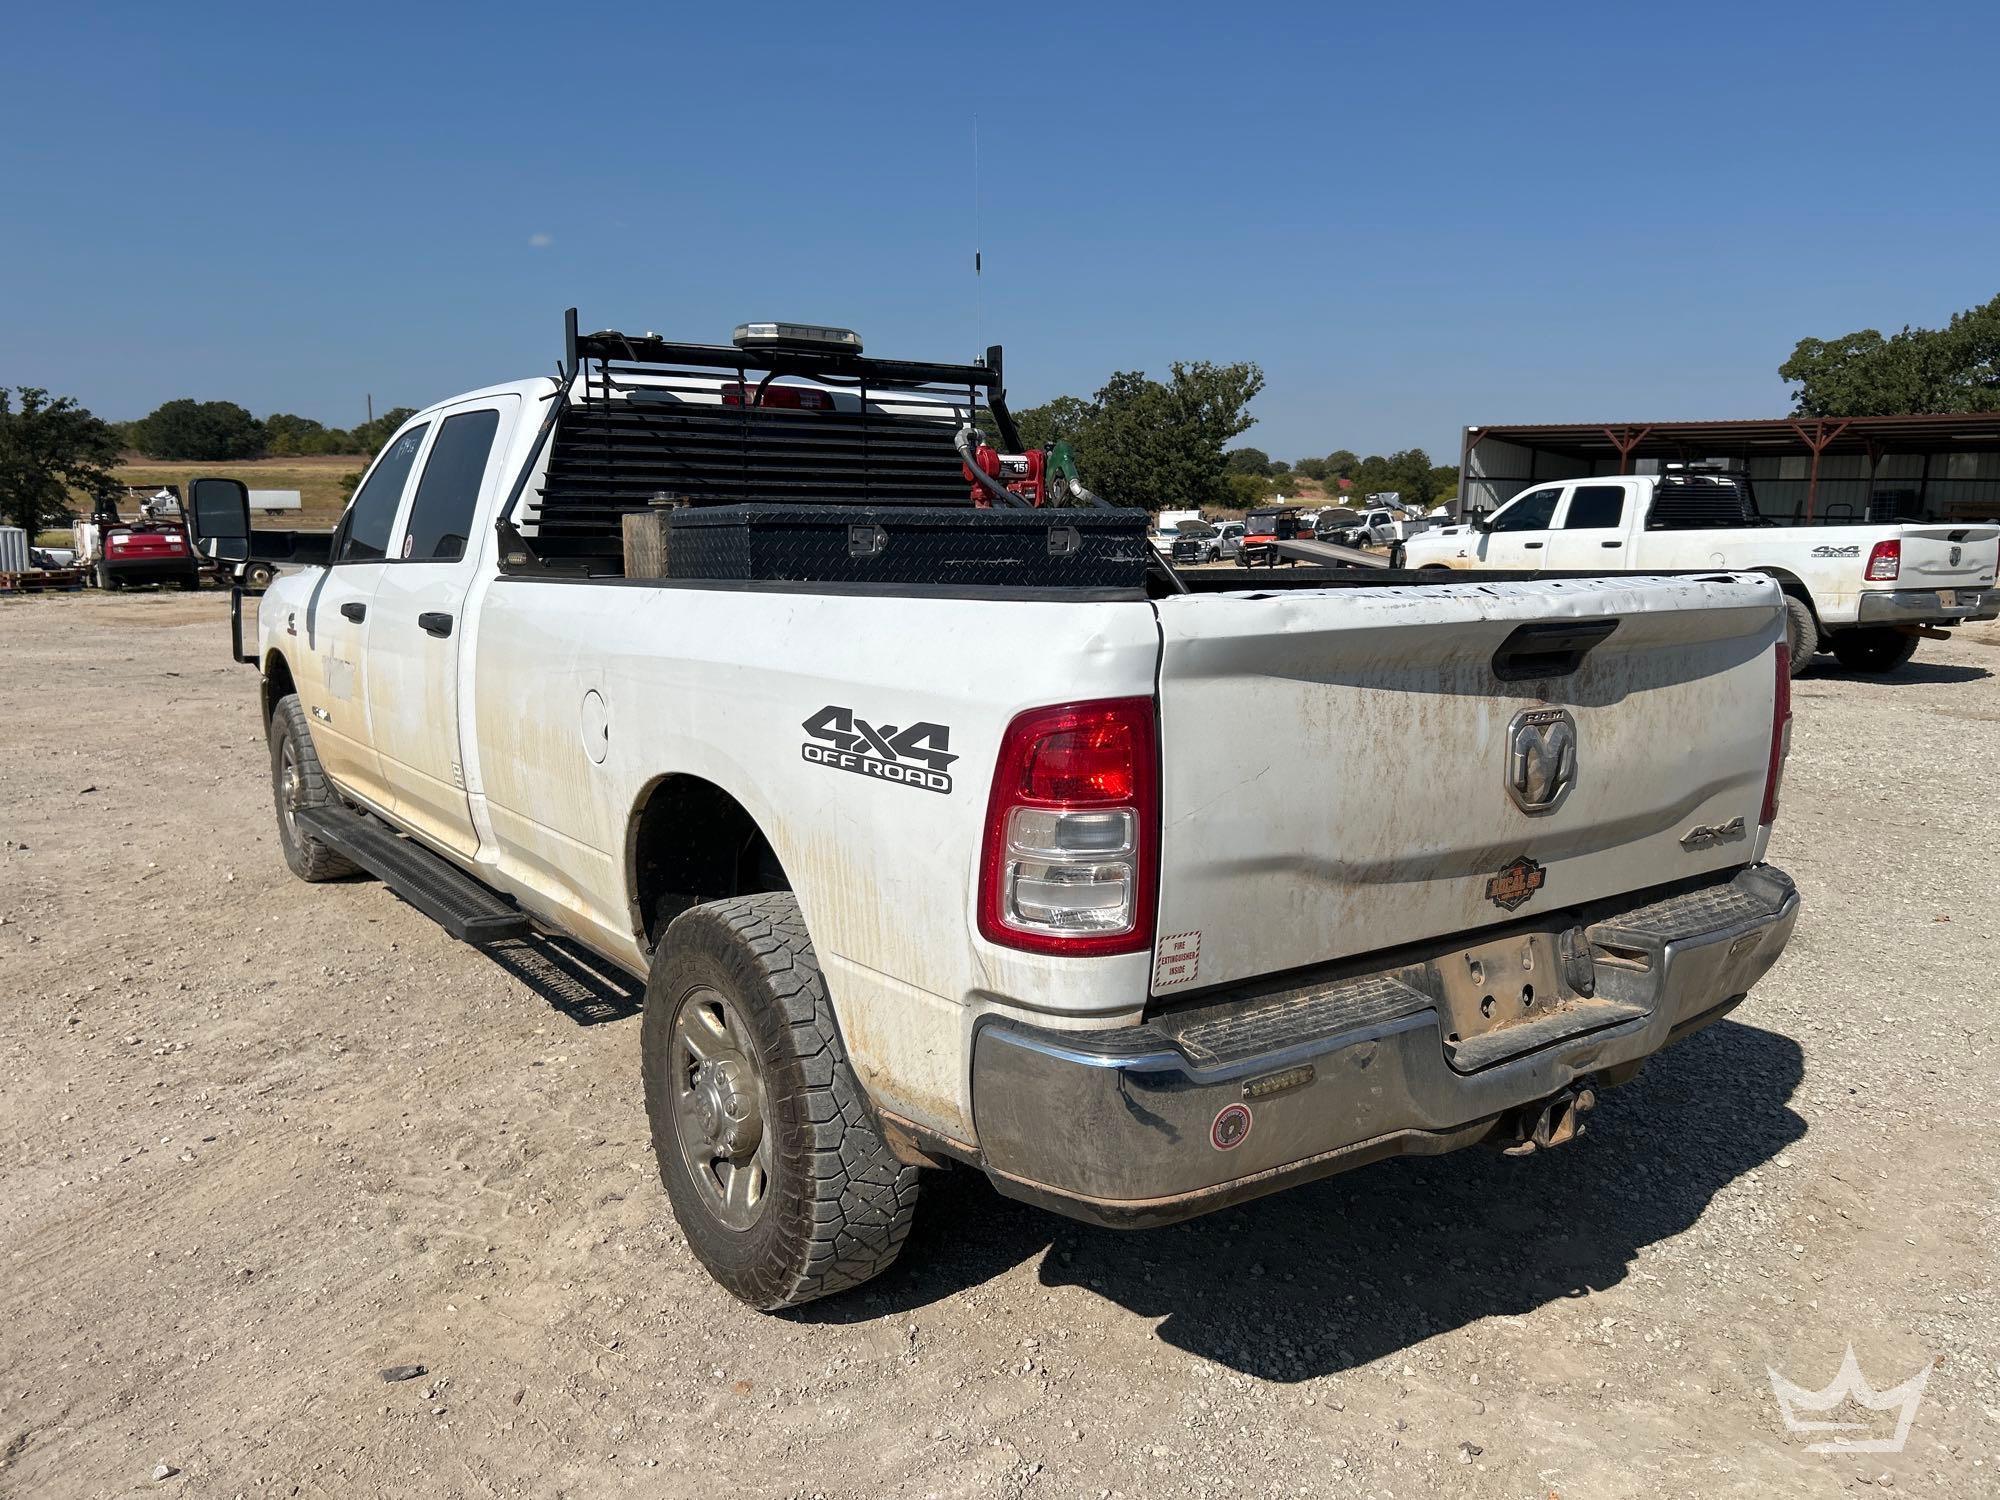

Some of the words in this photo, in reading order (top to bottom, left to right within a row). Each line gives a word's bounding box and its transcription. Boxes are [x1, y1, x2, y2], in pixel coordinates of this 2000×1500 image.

[804, 745, 857, 767] OFF
[863, 758, 949, 791] ROAD
[1174, 941, 1185, 950] FIRE
[1161, 952, 1196, 965] EXTINGUISHER
[1169, 965, 1185, 975] INSIDE
